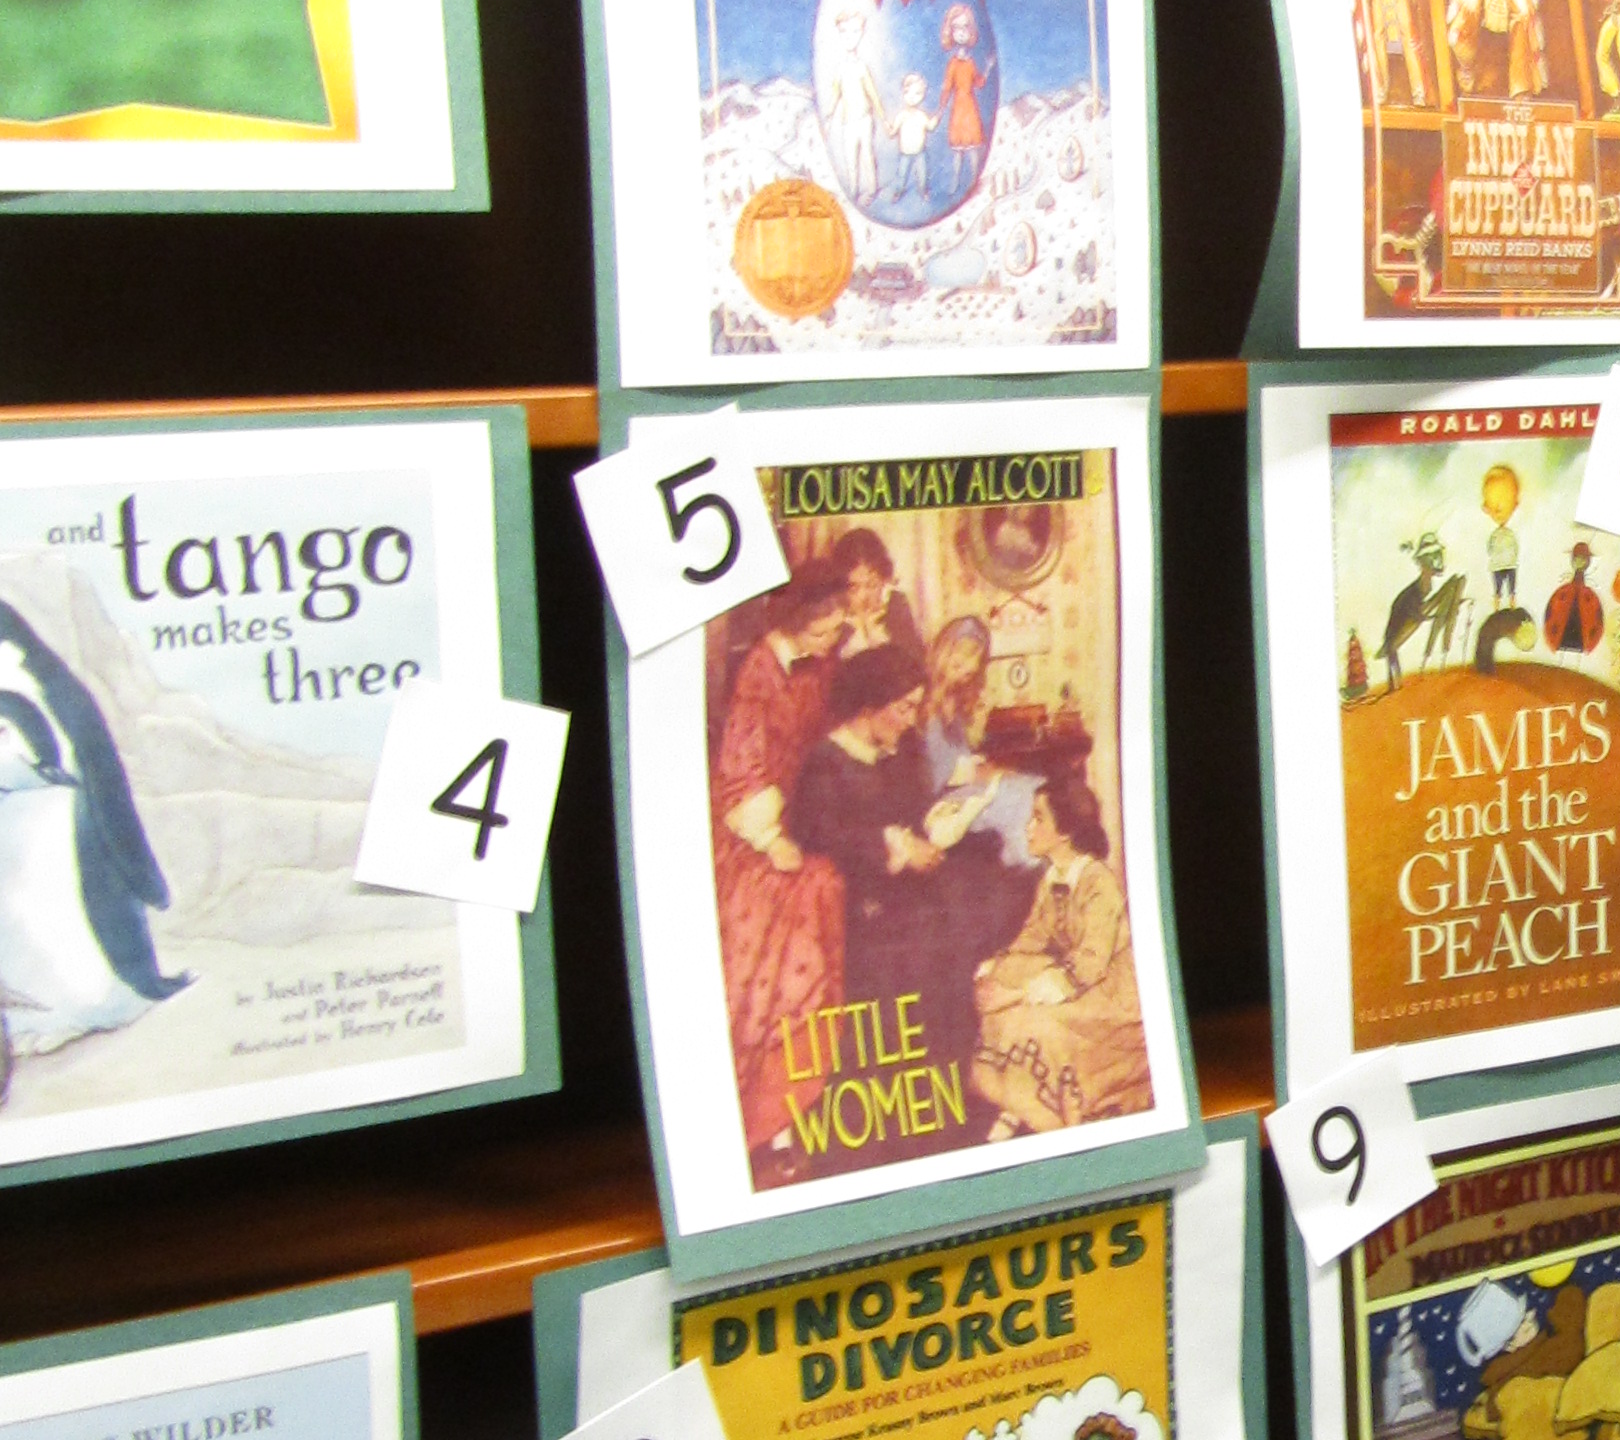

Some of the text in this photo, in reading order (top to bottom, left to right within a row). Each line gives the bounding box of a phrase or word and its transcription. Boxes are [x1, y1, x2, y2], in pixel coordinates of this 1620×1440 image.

[1463, 122, 1577, 180] INDIAN
[1502, 105, 1533, 122] THE
[1449, 179, 1598, 239] CUPBOARD
[1452, 241, 1594, 259] LYNNE REID BANKS
[1399, 408, 1597, 436] ROALD DAHL
[654, 456, 742, 586] 5
[782, 452, 1082, 516] LOUISA MAY ALCOTT
[47, 492, 415, 624] and tango
[152, 605, 293, 653] makes
[1394, 699, 1613, 802] JAMES
[429, 737, 511, 863] 4
[1424, 771, 1590, 844] and the
[1397, 827, 1617, 917] GIANT
[1401, 896, 1614, 987] PEACH
[780, 992, 929, 1084] LITTLE
[1357, 989, 1498, 1025] ILLUSTRATED
[1505, 984, 1531, 1000] BY
[786, 1060, 967, 1157] WOMEN
[1311, 1105, 1367, 1207] 9
[709, 1218, 1148, 1368] DINOSAURS
[779, 1340, 1093, 1436] A GUIDE FOR CHANGING FAMILIES
[800, 1289, 1076, 1404] DIVORCE
